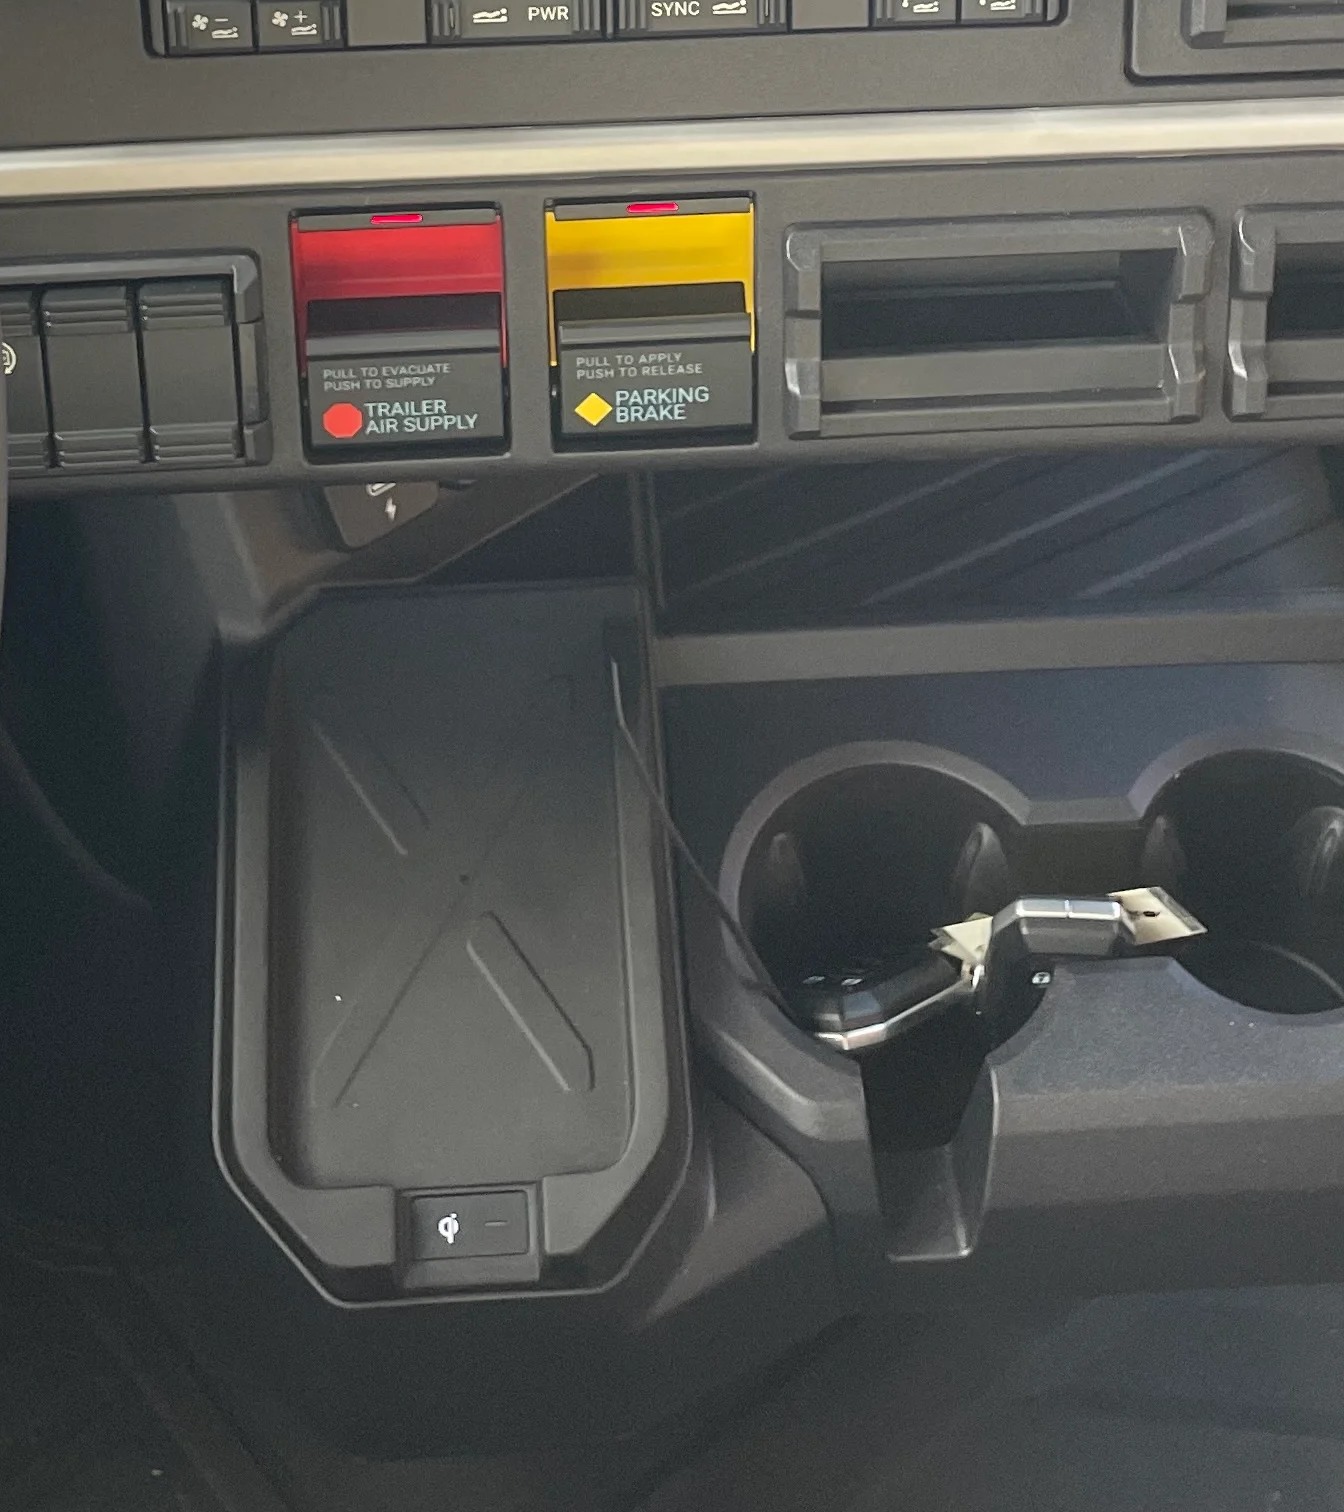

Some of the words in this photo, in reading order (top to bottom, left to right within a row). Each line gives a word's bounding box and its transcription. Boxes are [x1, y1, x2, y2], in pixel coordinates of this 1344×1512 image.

[528, 6, 569, 22] PWR
[651, 1, 700, 17] SYNC
[576, 356, 611, 368] PULL
[615, 354, 634, 365] TO
[638, 352, 682, 364] APPLY
[323, 368, 358, 380] PULL
[360, 366, 379, 377] TO
[382, 363, 451, 376] EVACUATE
[576, 368, 615, 380] PUSH
[619, 366, 638, 377] TO
[641, 363, 703, 376] RELEASE
[323, 380, 361, 392] PUSH
[364, 378, 382, 389] TO
[386, 376, 436, 388] SUPPLY
[616, 386, 709, 406] PARKING
[363, 399, 447, 418] TRAILER
[616, 404, 687, 423] BRAKE
[365, 418, 398, 435] AIR
[404, 414, 479, 433] SUPPLY
